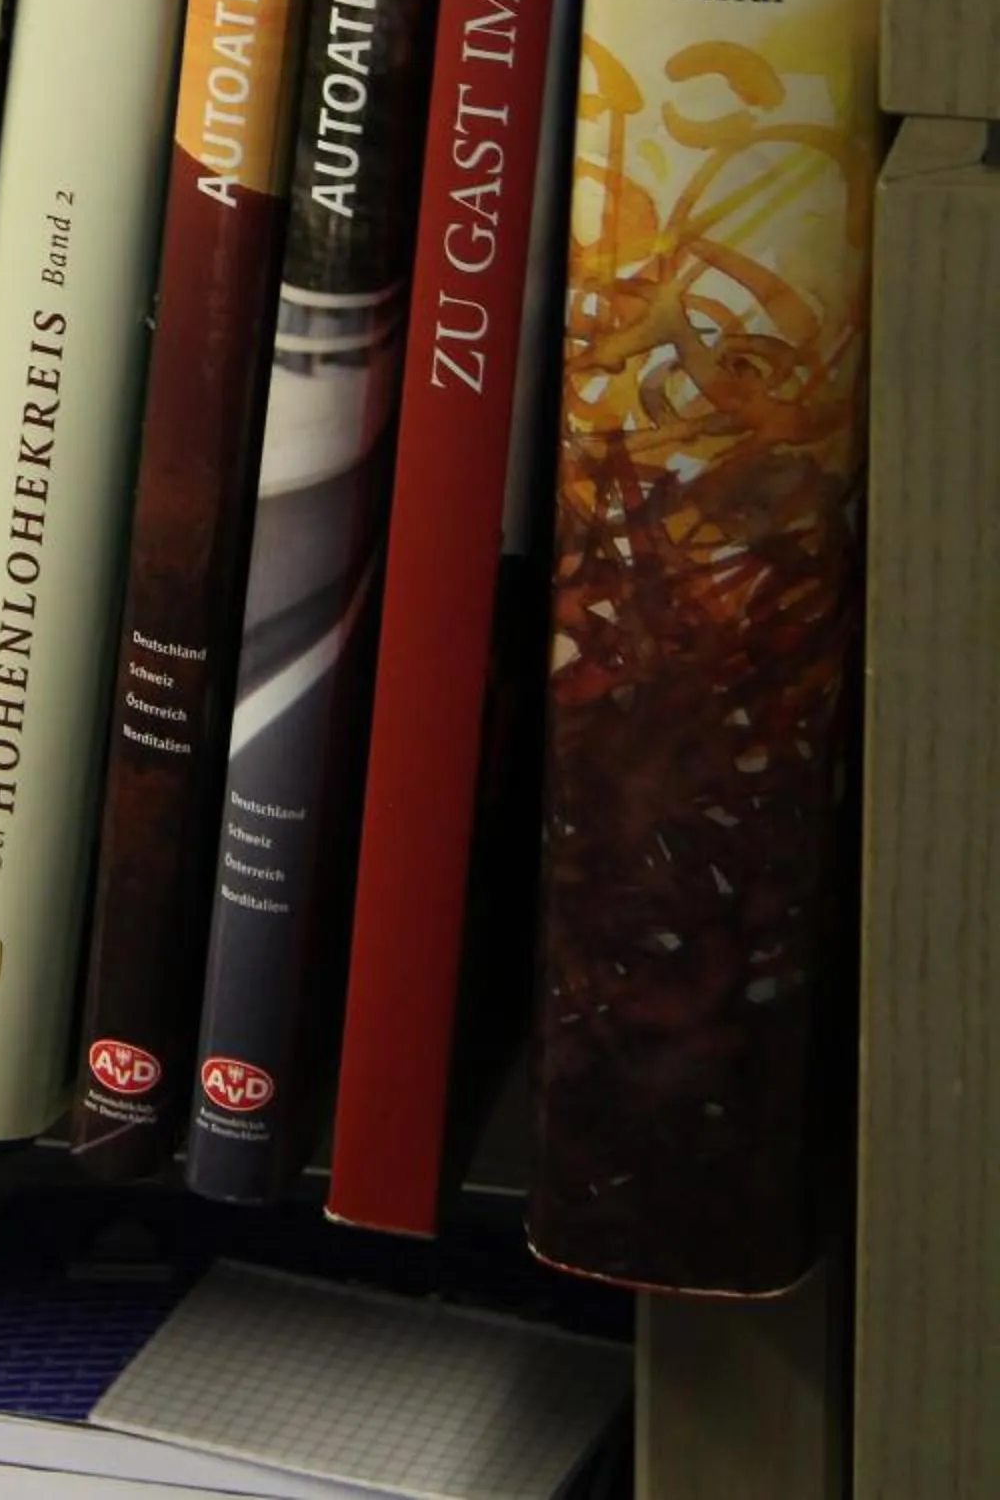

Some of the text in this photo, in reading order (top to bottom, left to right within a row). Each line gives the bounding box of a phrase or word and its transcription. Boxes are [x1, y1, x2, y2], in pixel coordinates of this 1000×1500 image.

[445, 85, 512, 276] GAST
[42, 214, 69, 287] Band
[56, 191, 74, 205] 2
[431, 297, 489, 395] ZU
[129, 661, 174, 688] Schweiz
[133, 630, 206, 660] Deutschland
